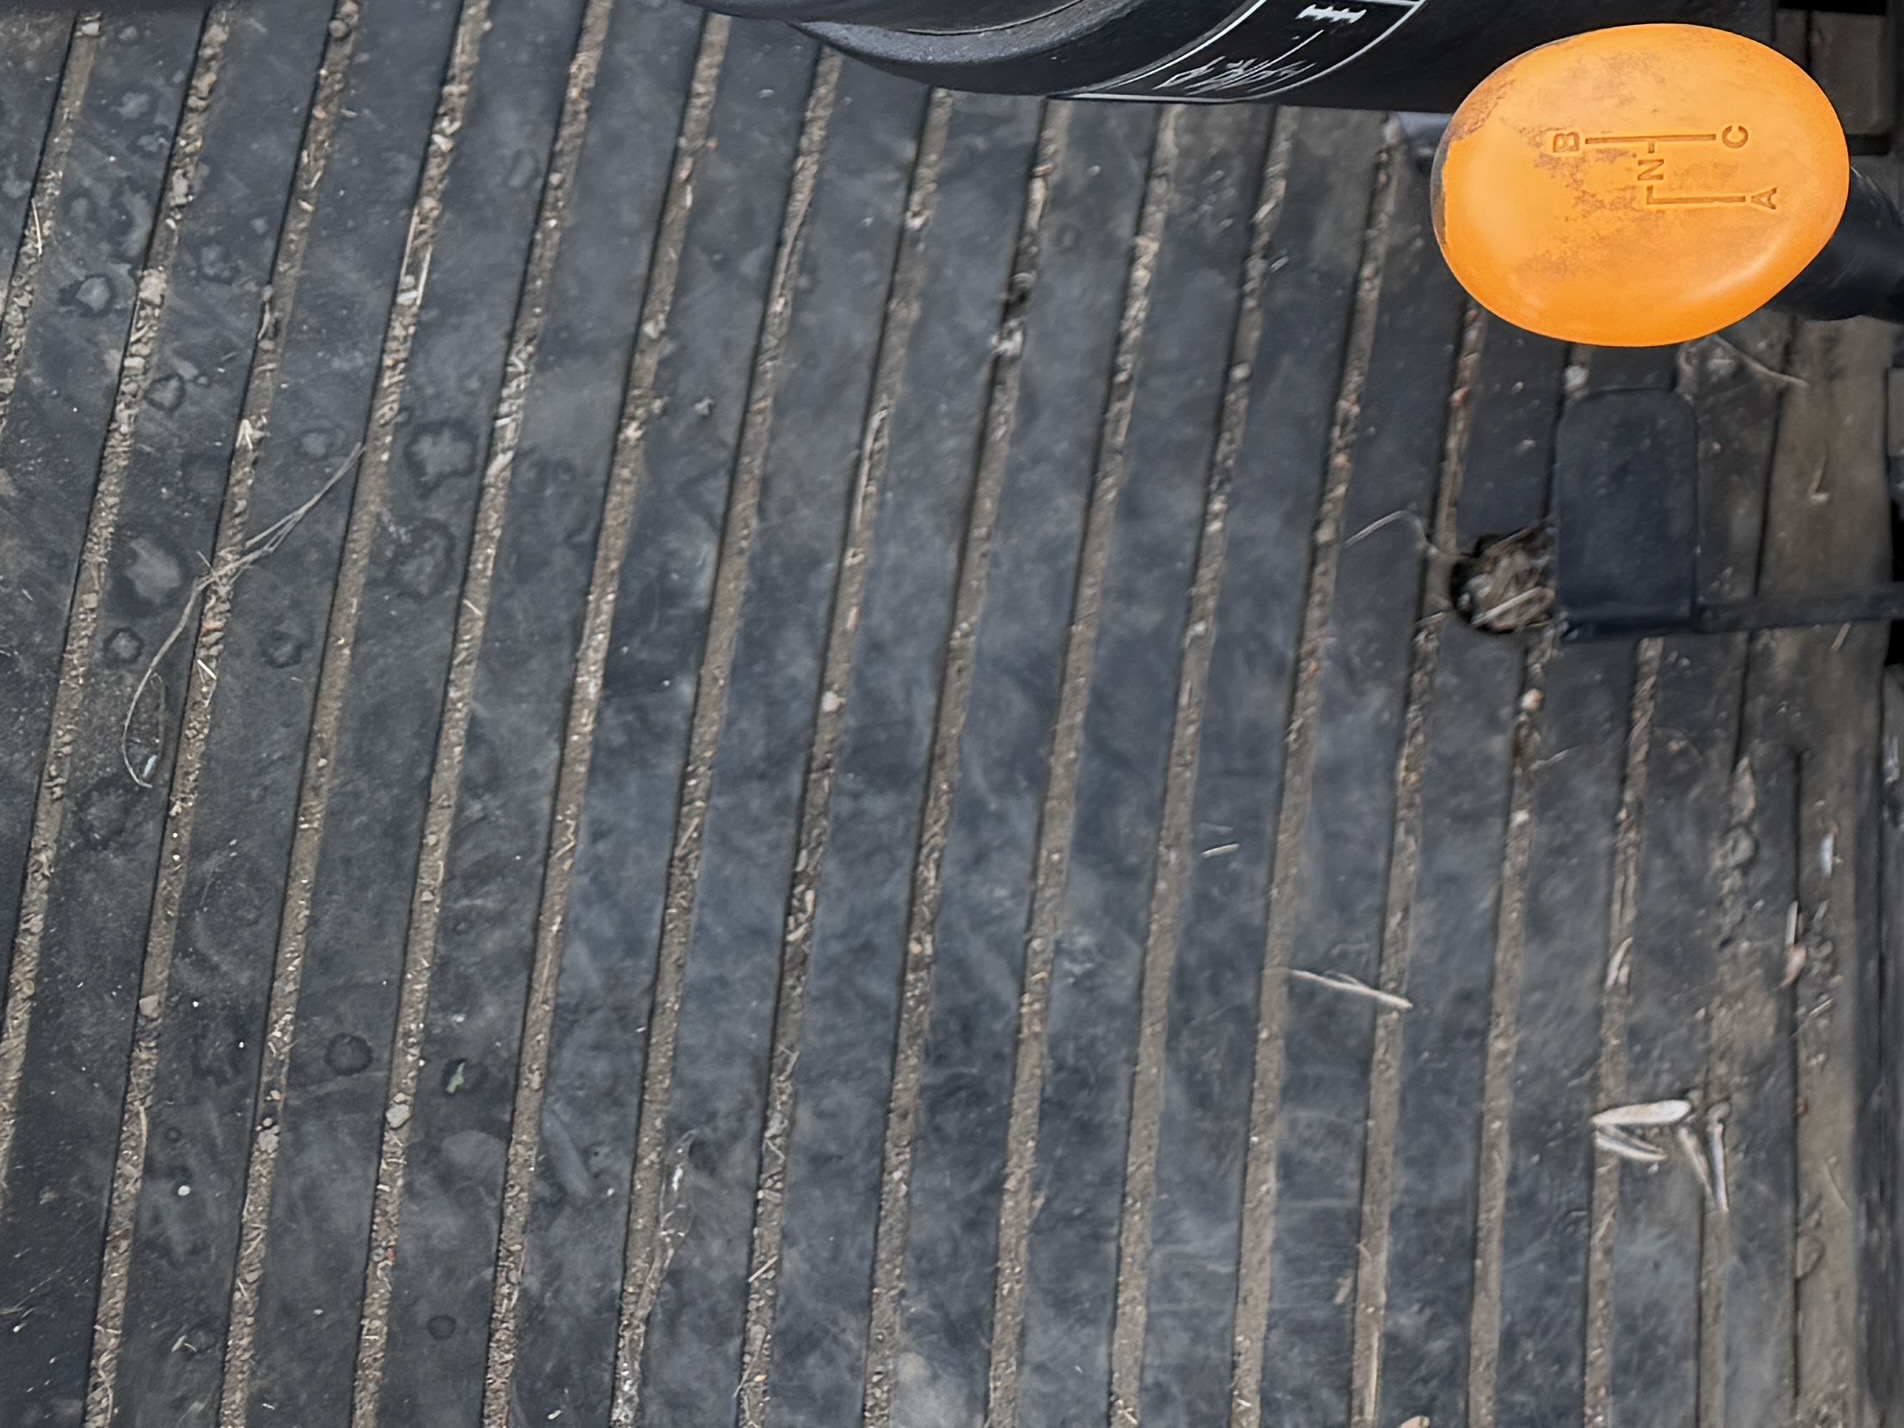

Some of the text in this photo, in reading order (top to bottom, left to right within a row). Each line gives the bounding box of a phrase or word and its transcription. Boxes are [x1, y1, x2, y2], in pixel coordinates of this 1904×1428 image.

[1551, 130, 1581, 154] B
[1720, 124, 1749, 150] C
[1636, 158, 1665, 182] N
[1750, 186, 1778, 211] A
